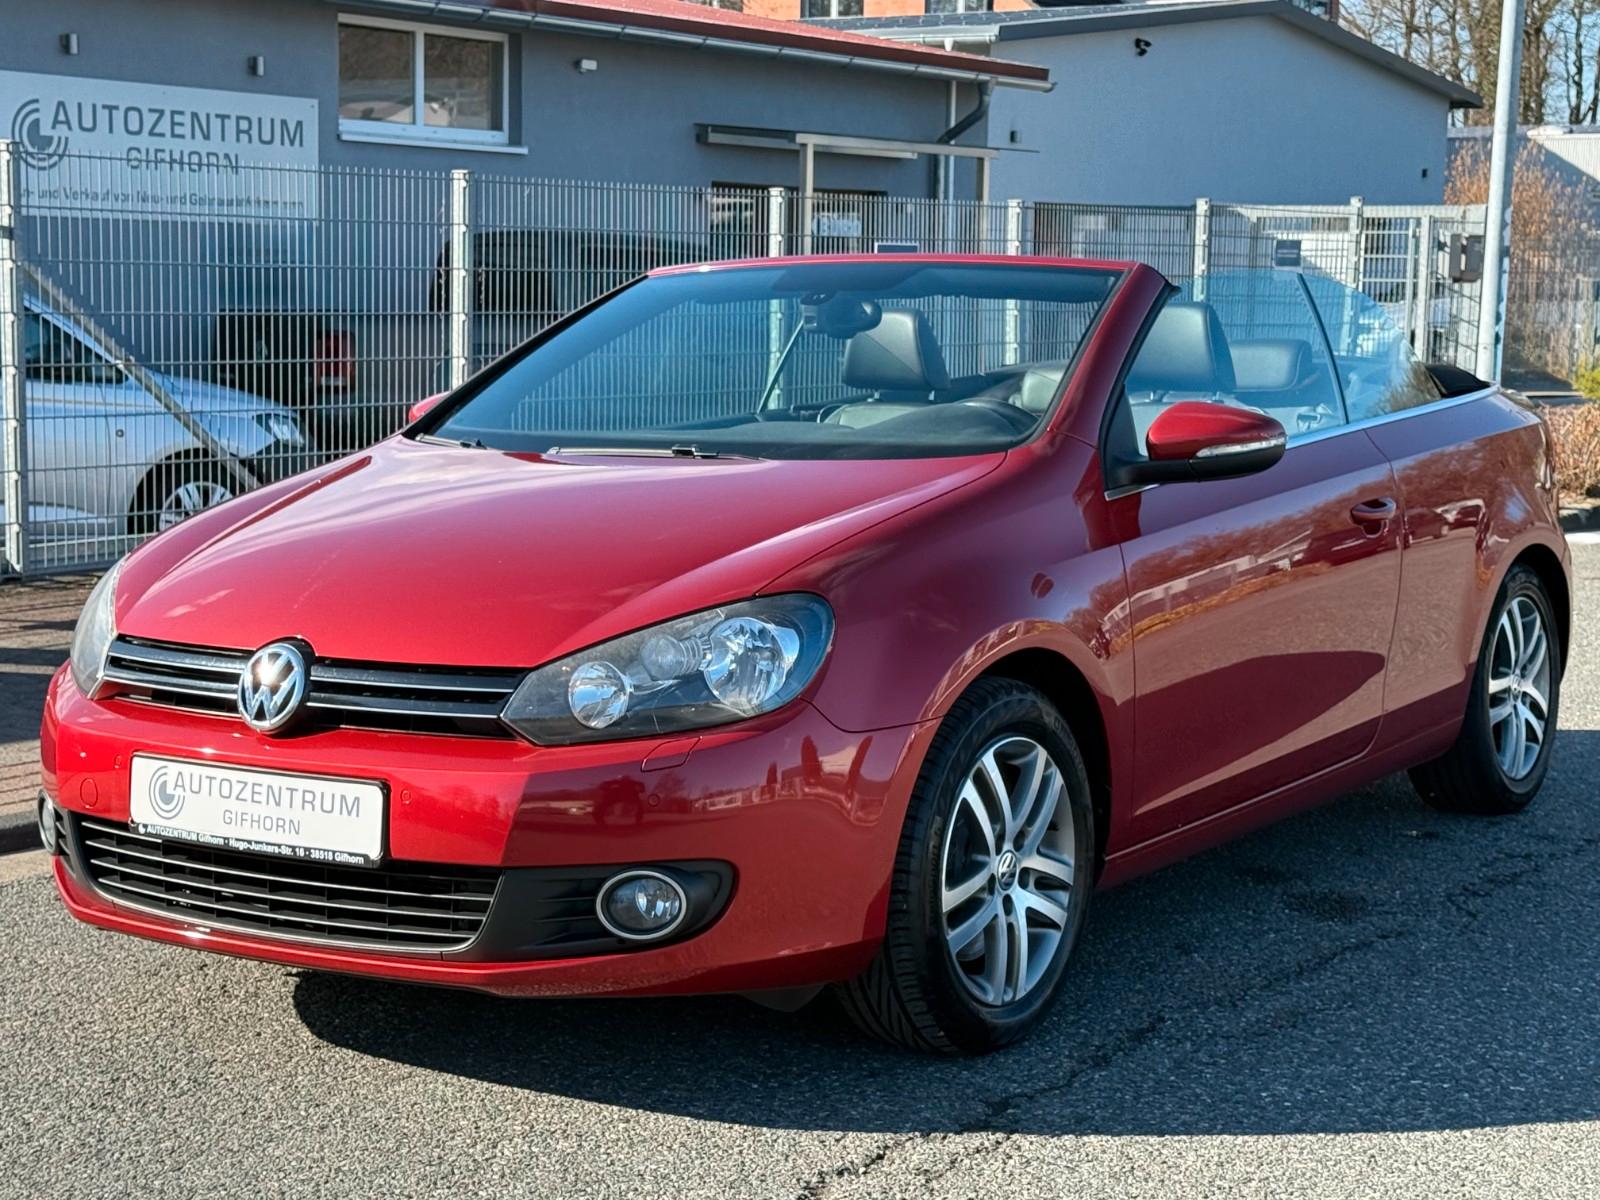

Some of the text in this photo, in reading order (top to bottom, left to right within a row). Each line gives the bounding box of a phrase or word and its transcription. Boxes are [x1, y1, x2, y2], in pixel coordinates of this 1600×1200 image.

[51, 100, 304, 148] AUTOZENTRUM
[126, 146, 239, 175] GIFHORN
[173, 770, 361, 818] AUTOZENTRUM
[222, 808, 300, 835] GIFHORN
[146, 823, 198, 841] AUTOZENTRUM
[334, 851, 365, 865] Gifhorn
